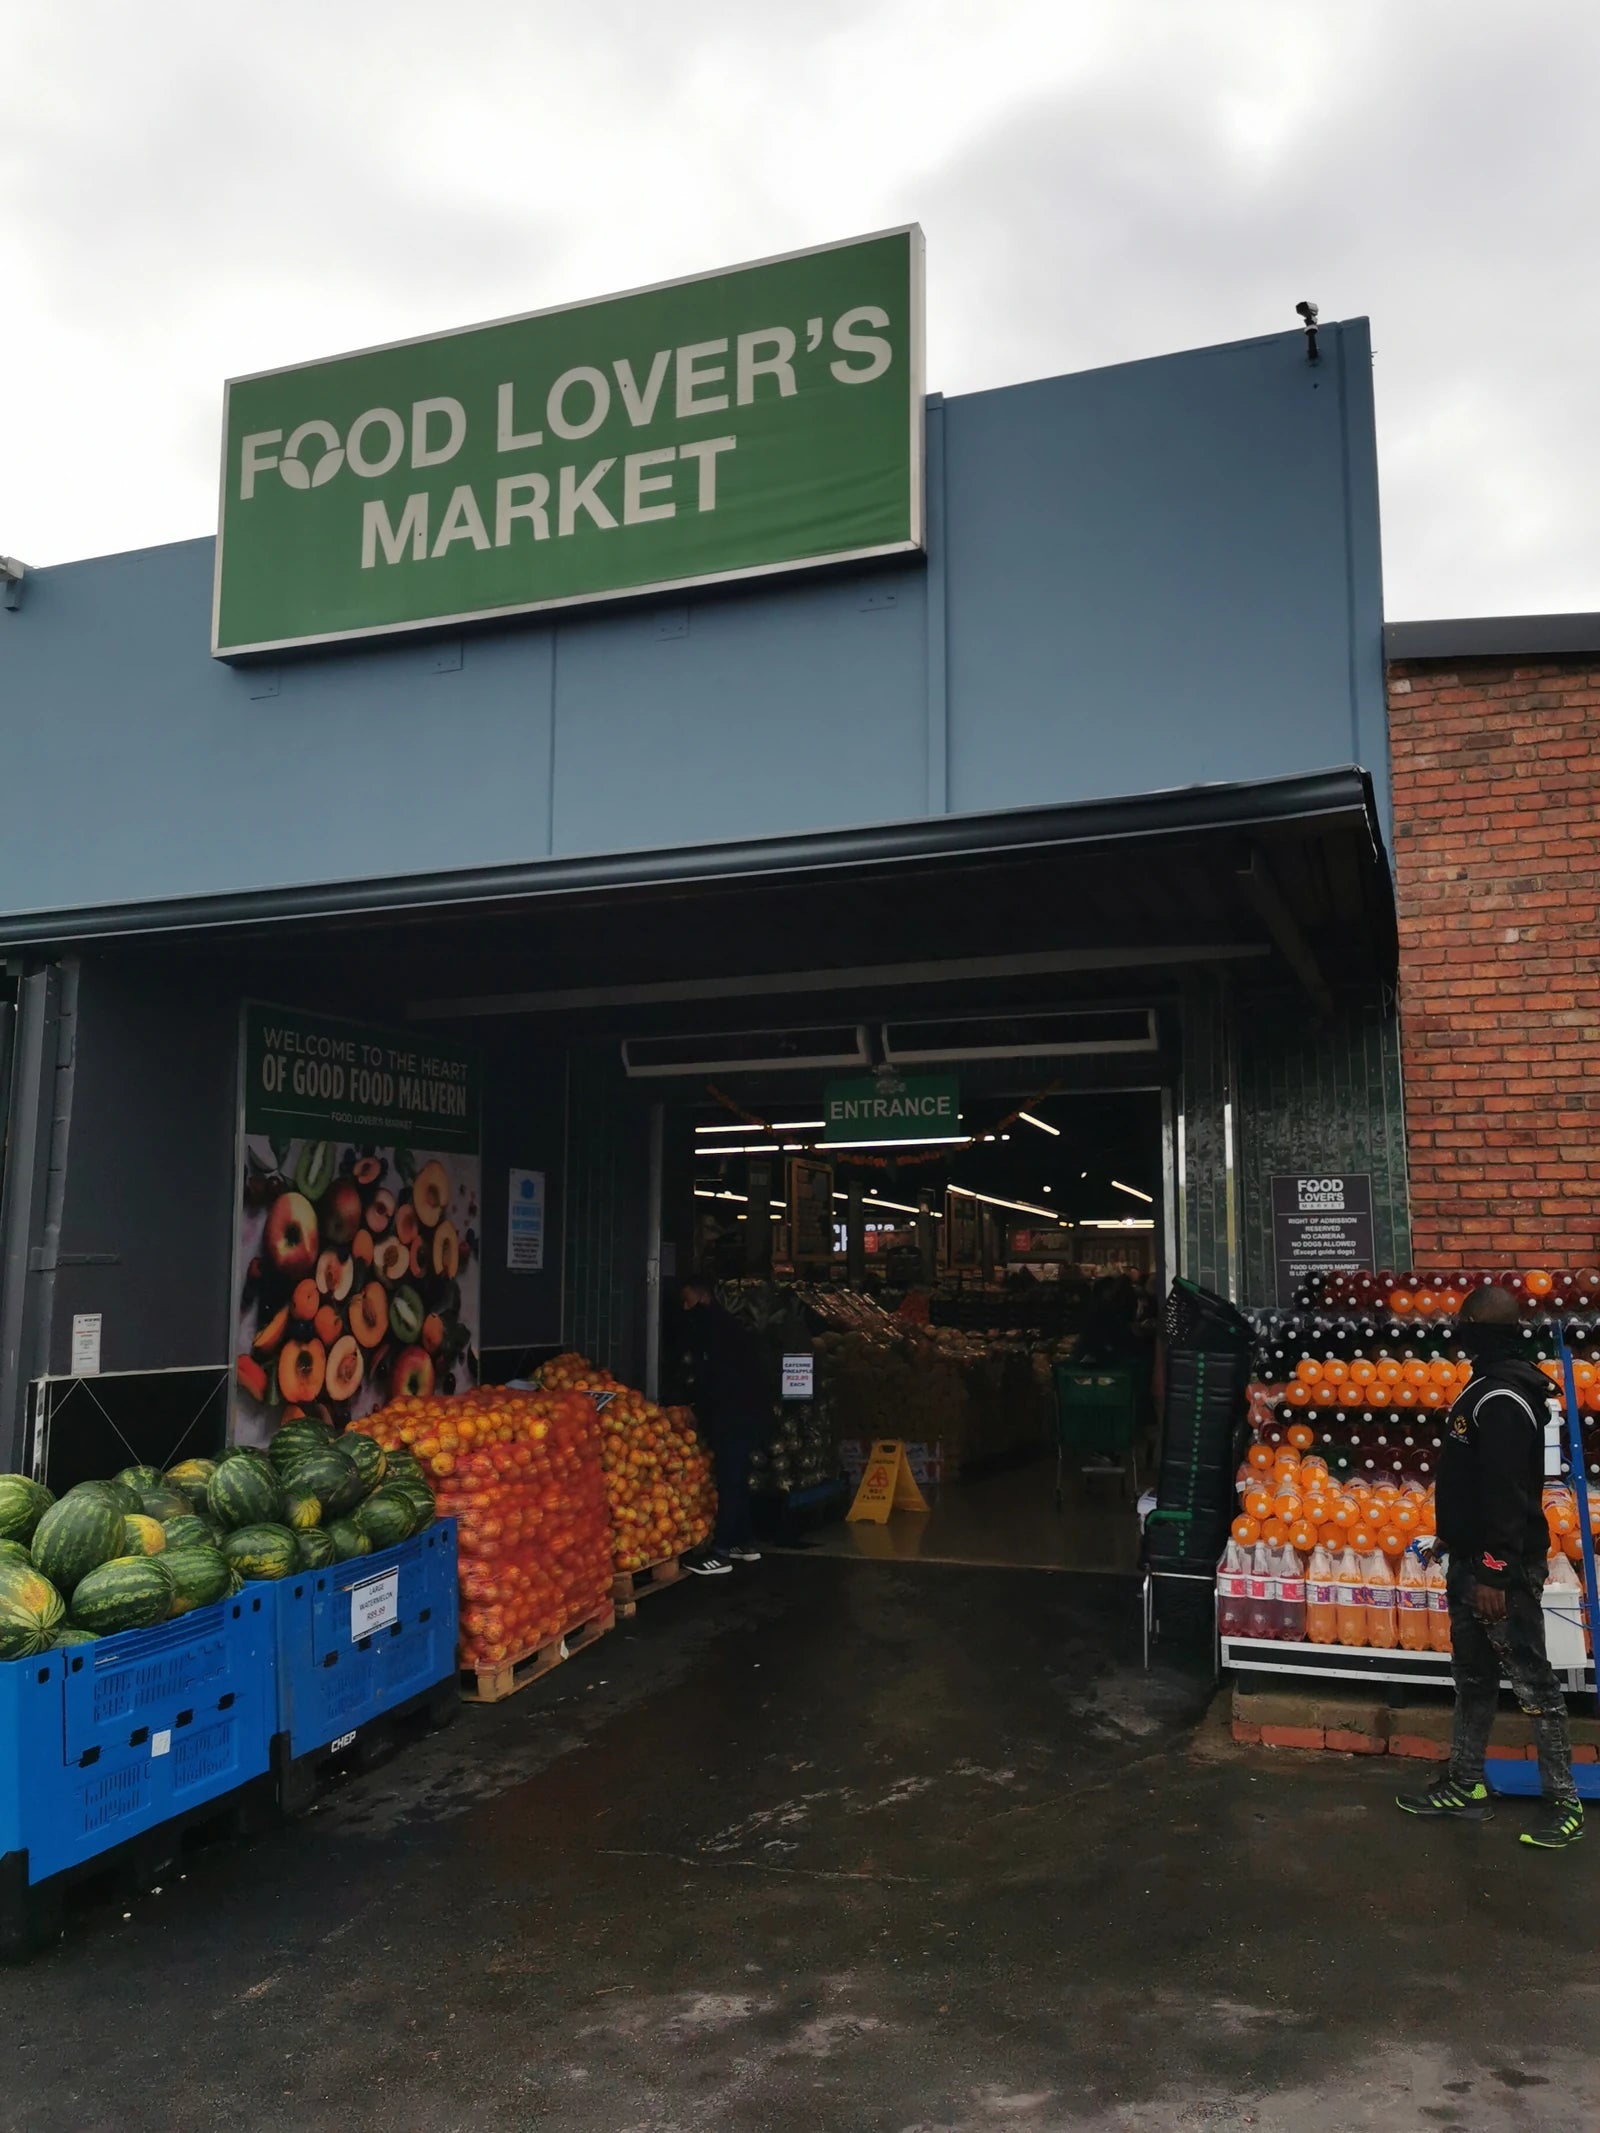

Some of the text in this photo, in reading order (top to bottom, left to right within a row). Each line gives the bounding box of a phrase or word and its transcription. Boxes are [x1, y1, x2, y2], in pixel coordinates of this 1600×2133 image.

[240, 306, 893, 500] FOOD LOVER'S
[361, 435, 737, 568] MARKET
[263, 1027, 468, 1080] WELCOME TO THE HEART
[262, 1053, 466, 1117] OF GOOD FOOD MALVERN
[331, 1111, 353, 1123] FOOD
[830, 1096, 951, 1120] ENTRANCE
[1297, 1179, 1344, 1192] FOOD
[1298, 1192, 1344, 1202] LOVER'S
[360, 1591, 393, 1610] WATERMELON
[331, 1730, 357, 1753] CHEP
